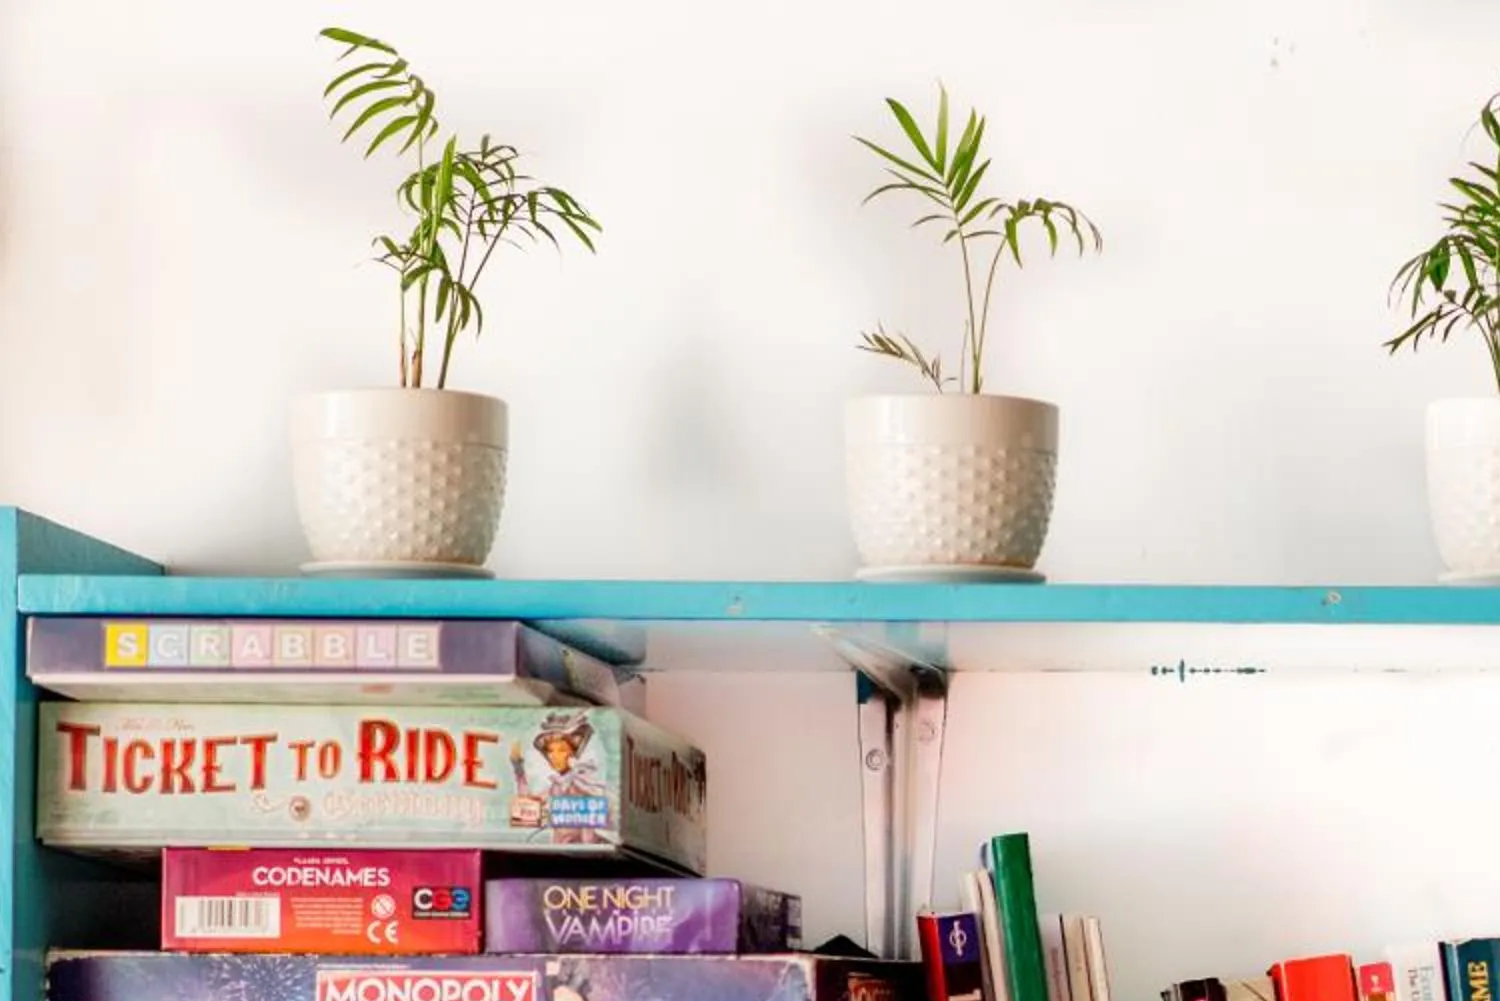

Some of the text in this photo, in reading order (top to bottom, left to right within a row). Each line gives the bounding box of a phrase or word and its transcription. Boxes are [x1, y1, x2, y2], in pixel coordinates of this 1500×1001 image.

[115, 632, 431, 660] SCRABBLE
[57, 719, 500, 794] TICKET TO RIDE
[252, 866, 391, 887] CODENAMES
[544, 886, 676, 911] ONE NIGHT
[544, 911, 674, 944] VAMPIRE
